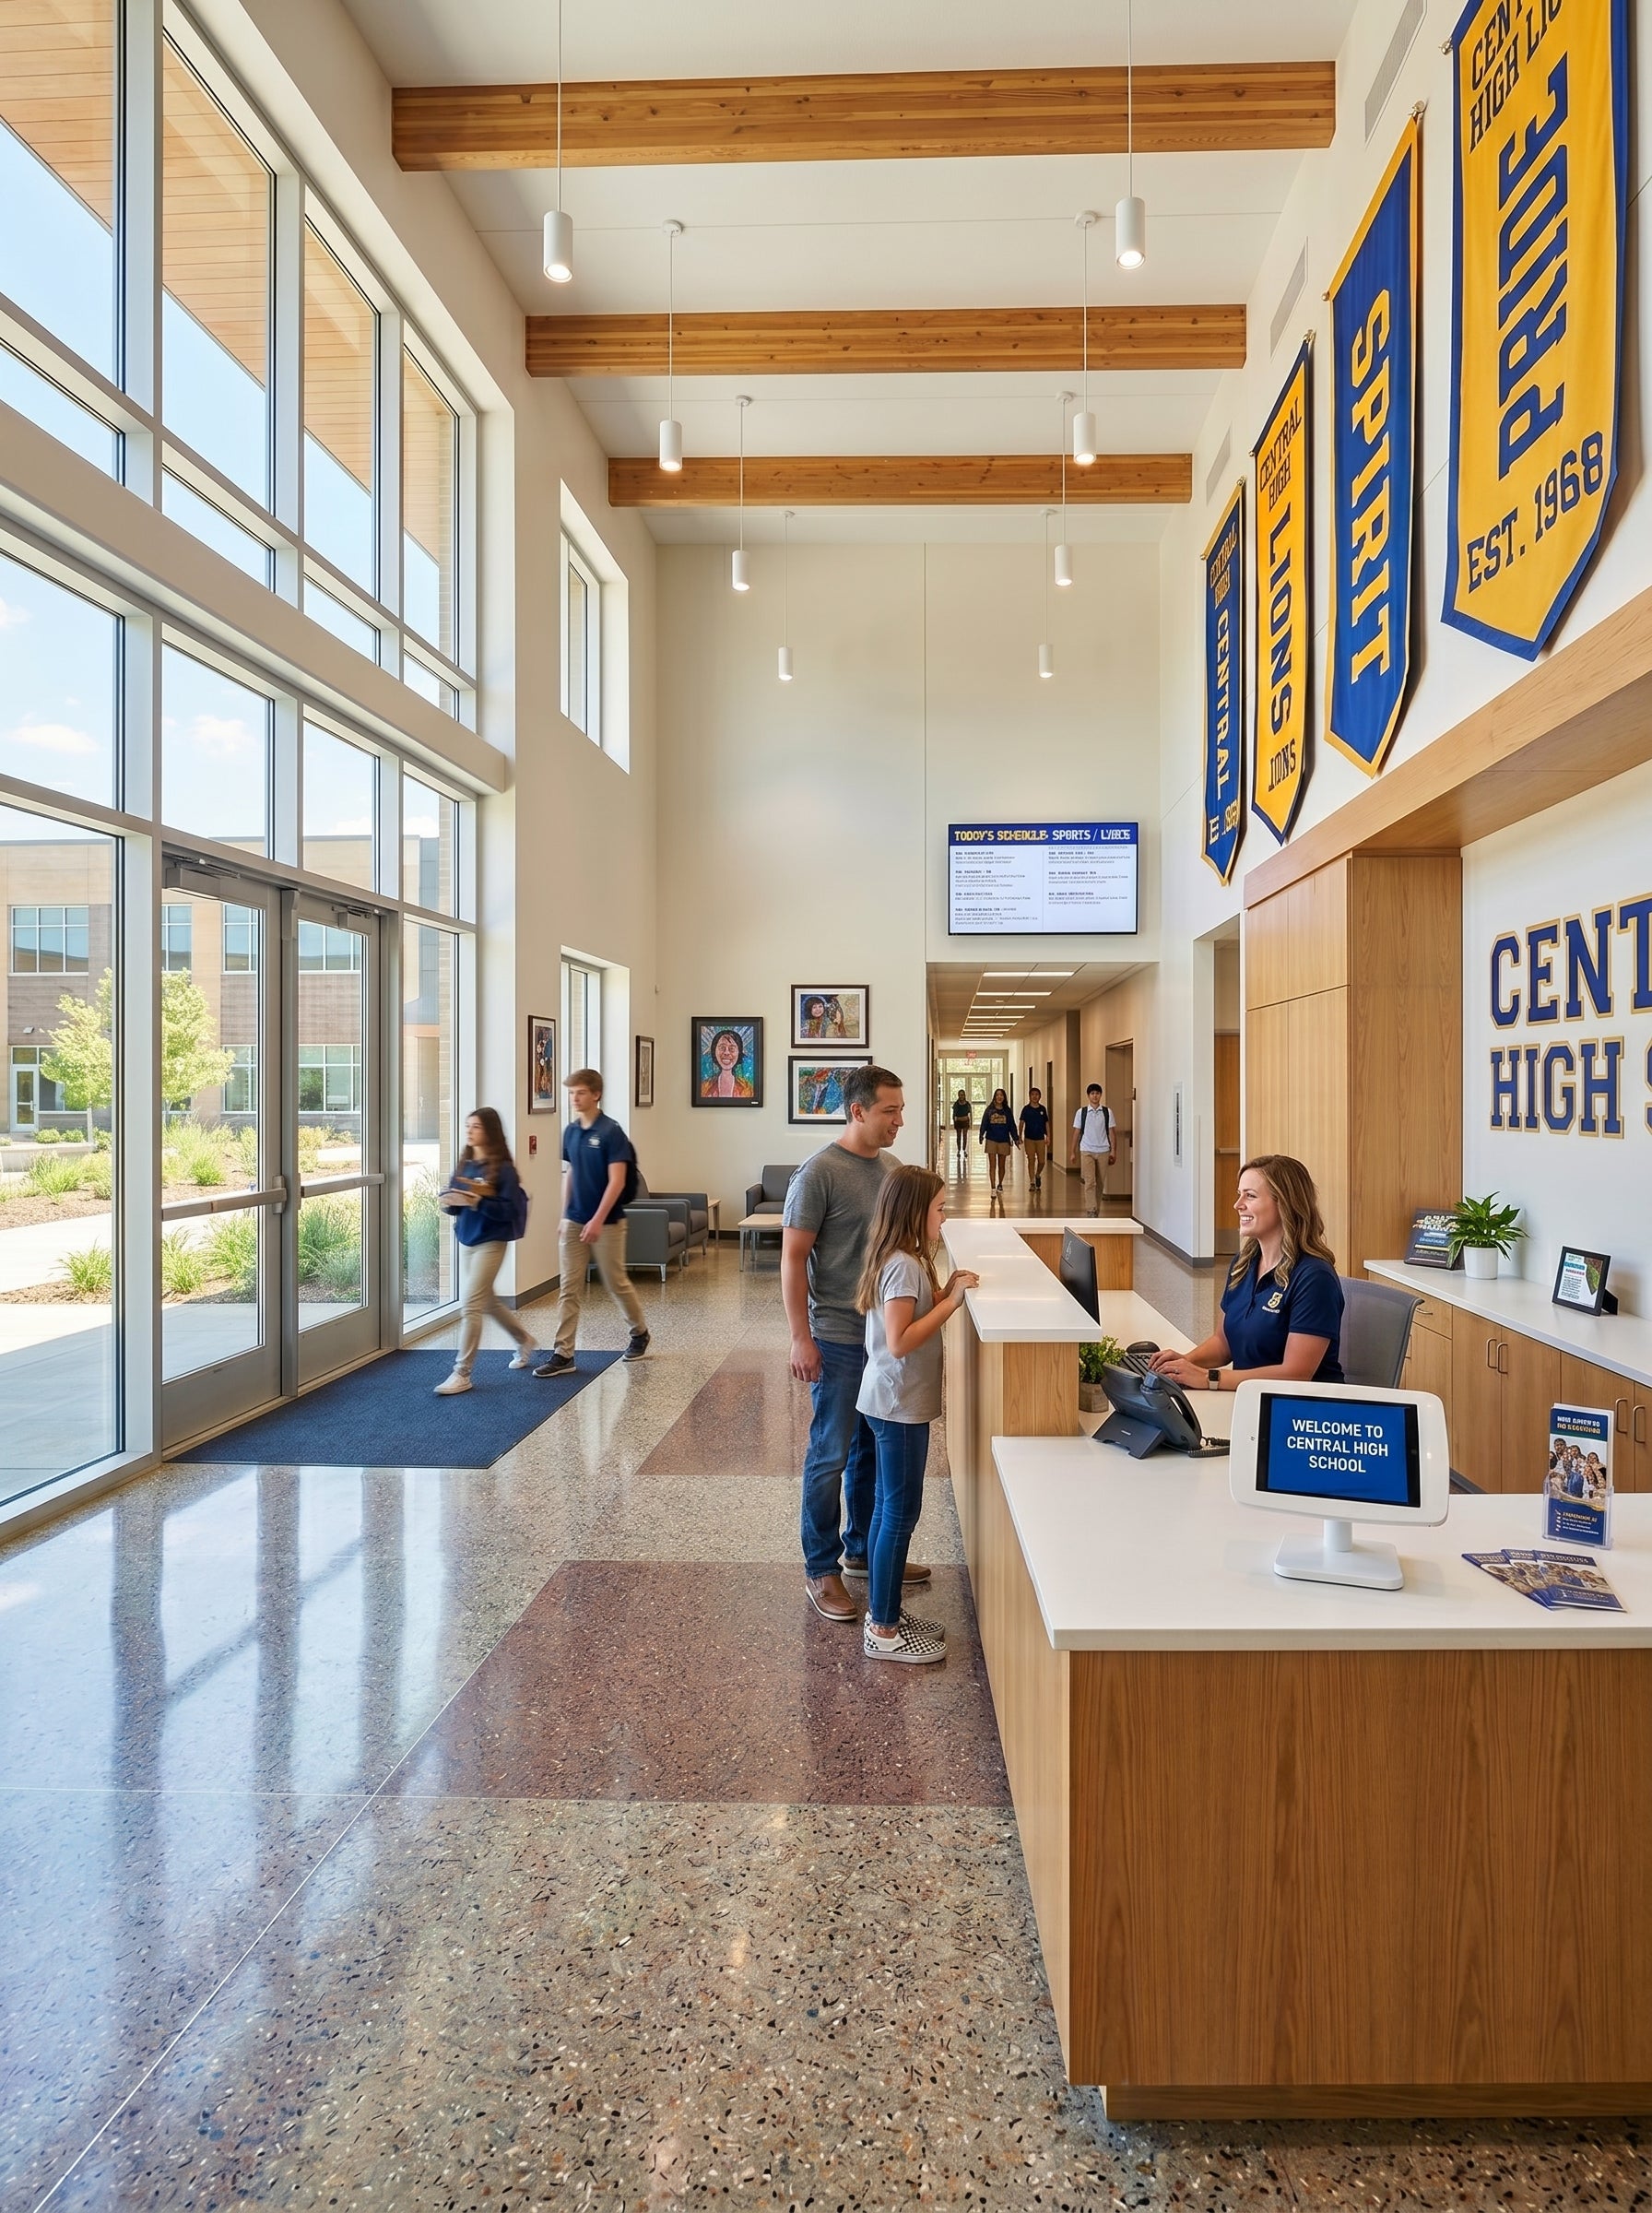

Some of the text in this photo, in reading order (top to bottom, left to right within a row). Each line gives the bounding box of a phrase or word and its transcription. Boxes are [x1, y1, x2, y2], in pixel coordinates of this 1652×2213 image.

[1469, 32, 1519, 154] HIGH
[1498, 52, 1567, 480] PRIDE
[1260, 397, 1302, 492] CENTRAL
[1268, 451, 1291, 513] HIGH
[1351, 289, 1390, 684] SPIRIT
[1467, 431, 1604, 594] EST. 1968
[1269, 501, 1292, 736] LIONS
[1217, 608, 1230, 801] CENTRAL
[1490, 1035, 1624, 1139] HIGH
[1286, 1436, 1388, 1457] CENTRAL HIGH
[1292, 1418, 1384, 1438] WELCOME TO
[1308, 1455, 1366, 1473] SCHOOL
